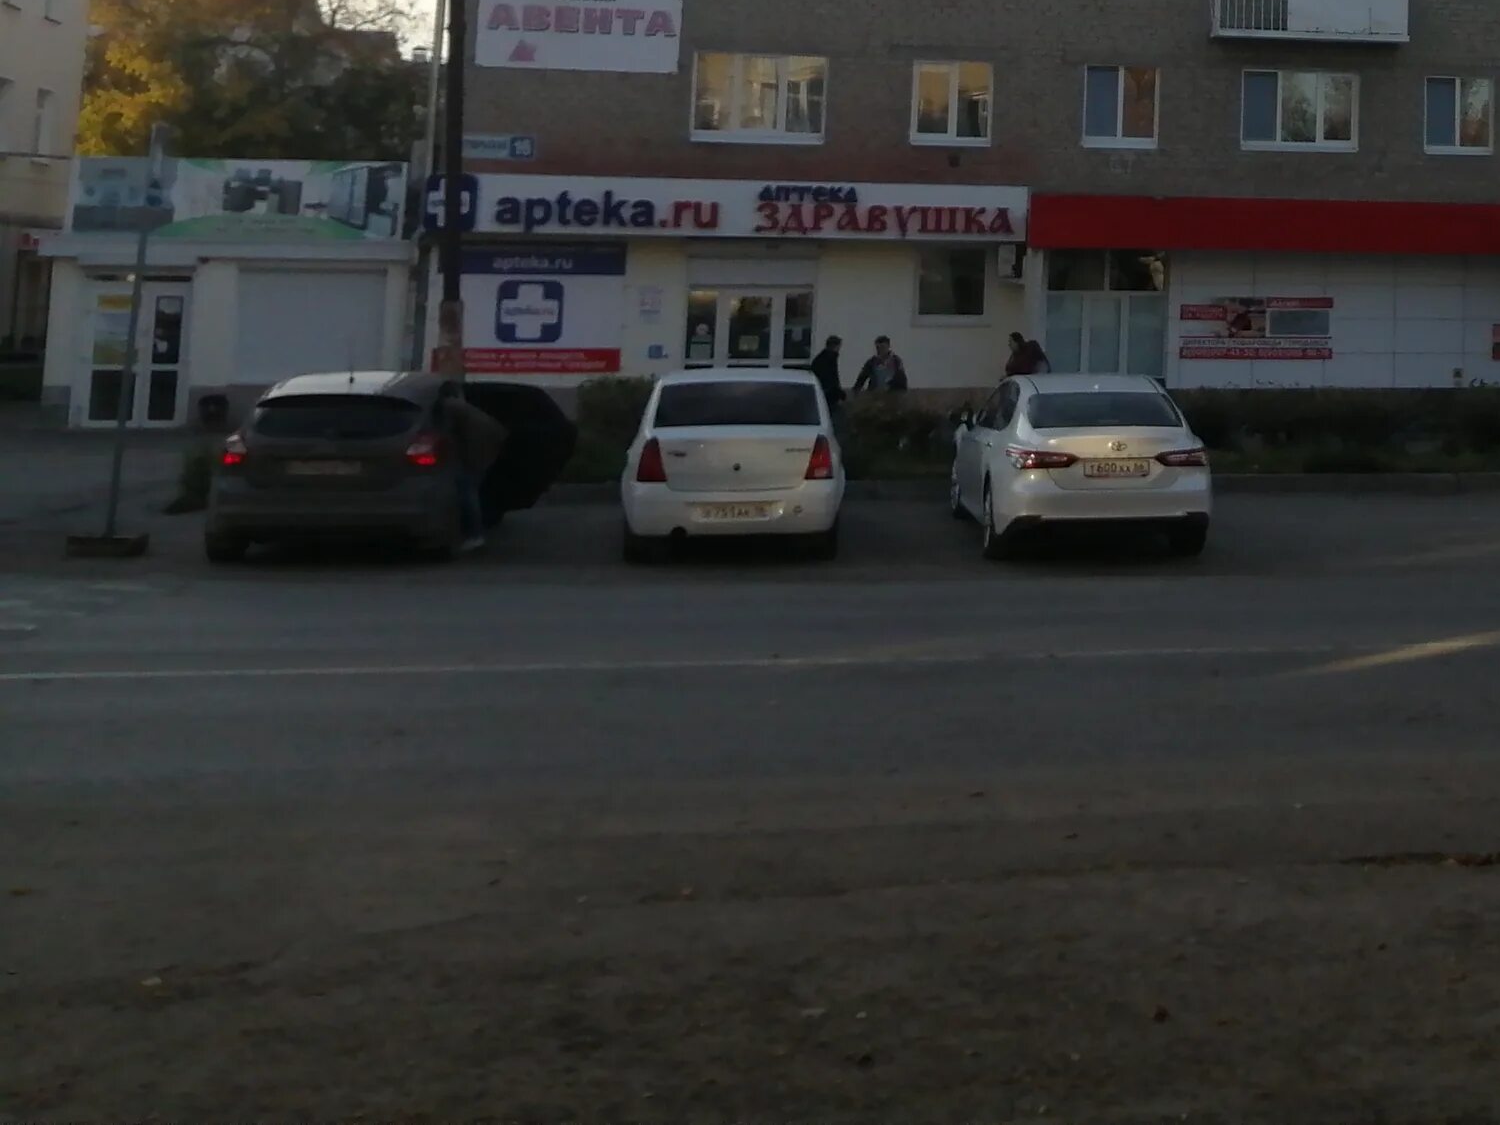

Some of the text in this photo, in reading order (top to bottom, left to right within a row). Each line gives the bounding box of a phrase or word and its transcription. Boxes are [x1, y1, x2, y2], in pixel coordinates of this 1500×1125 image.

[487, 4, 677, 37] АВЕНТА
[495, 190, 719, 232] apteka.ru
[754, 202, 1014, 237] ЗДРАВУШКА
[492, 255, 573, 270] apteka.ru
